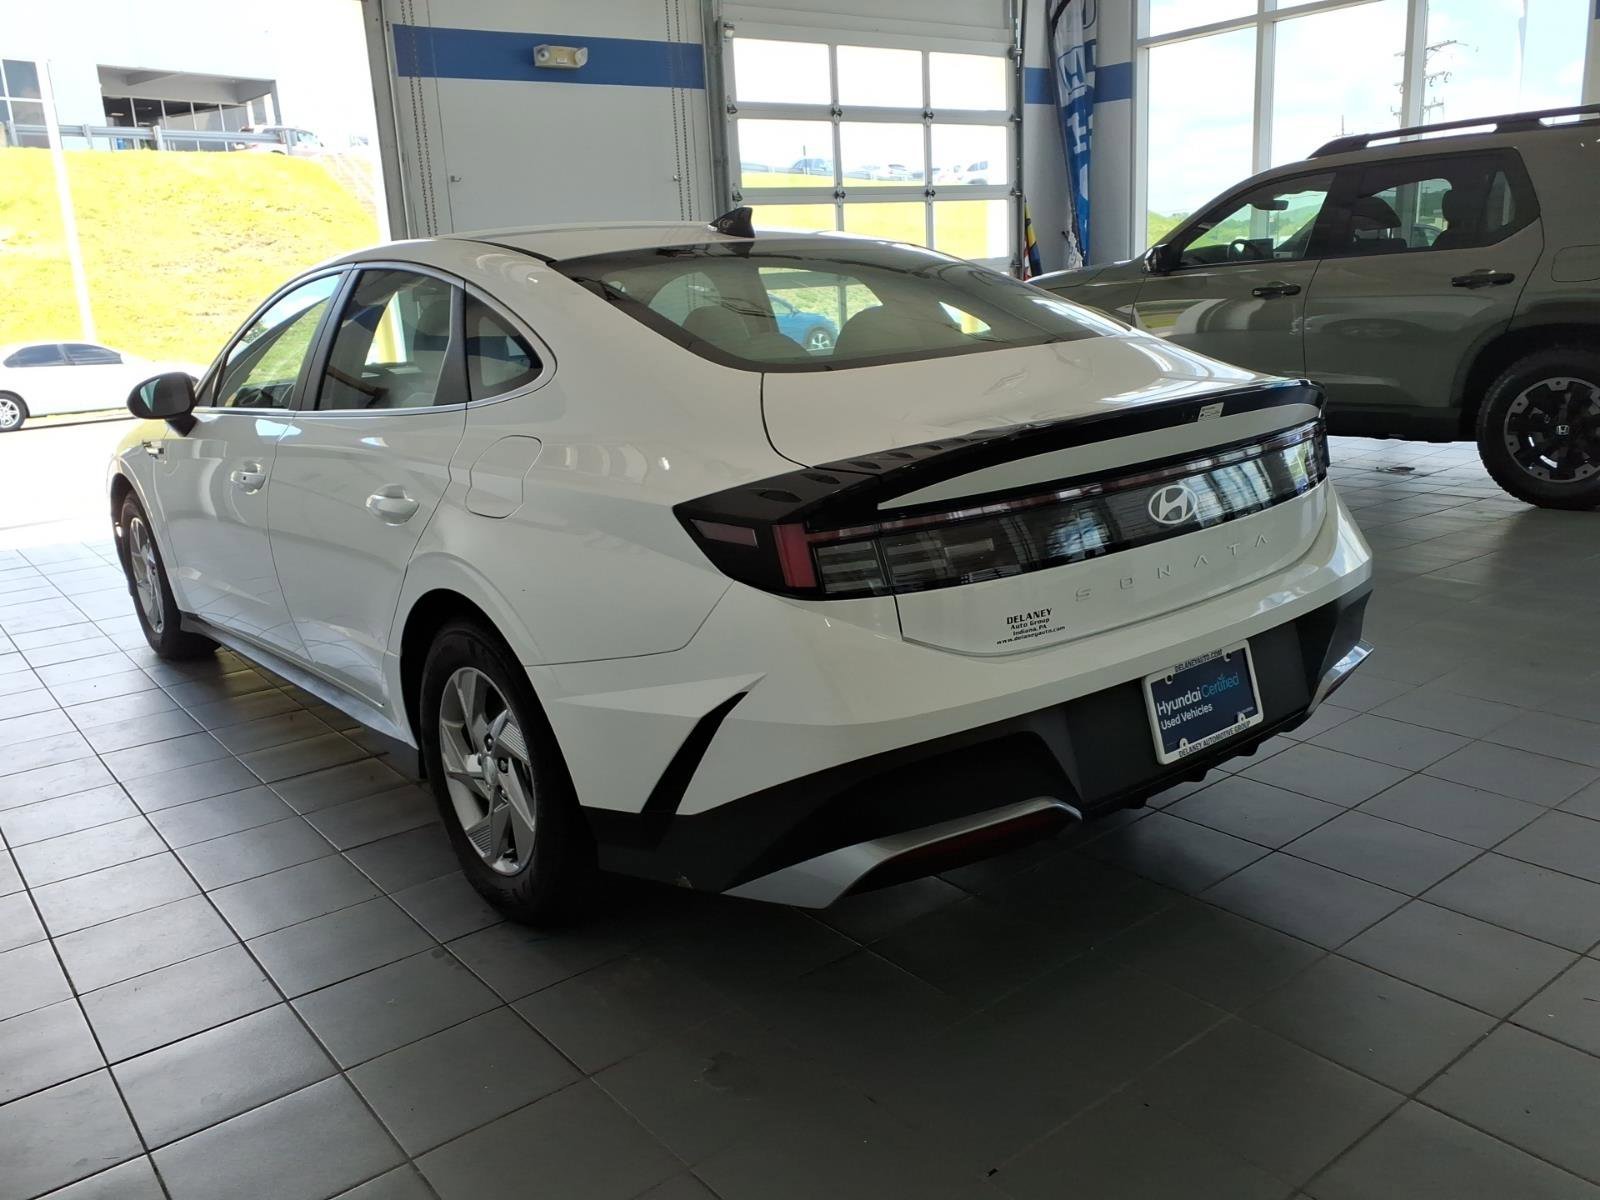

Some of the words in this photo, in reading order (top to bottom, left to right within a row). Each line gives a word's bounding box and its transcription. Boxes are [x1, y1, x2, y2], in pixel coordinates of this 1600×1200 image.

[1075, 533, 1270, 602] SONATA
[1006, 608, 1053, 625] DELANEY
[1011, 621, 1028, 630] Auto
[1029, 617, 1050, 626] Group
[1156, 686, 1202, 716] Hyundai
[1201, 674, 1240, 698] Certified
[1160, 715, 1181, 730] Used
[1181, 703, 1213, 722] Vehicles
[1178, 743, 1201, 758] DELANEY
[1203, 729, 1234, 747] AUTOMOTIVE
[1234, 721, 1251, 733] GROUP
